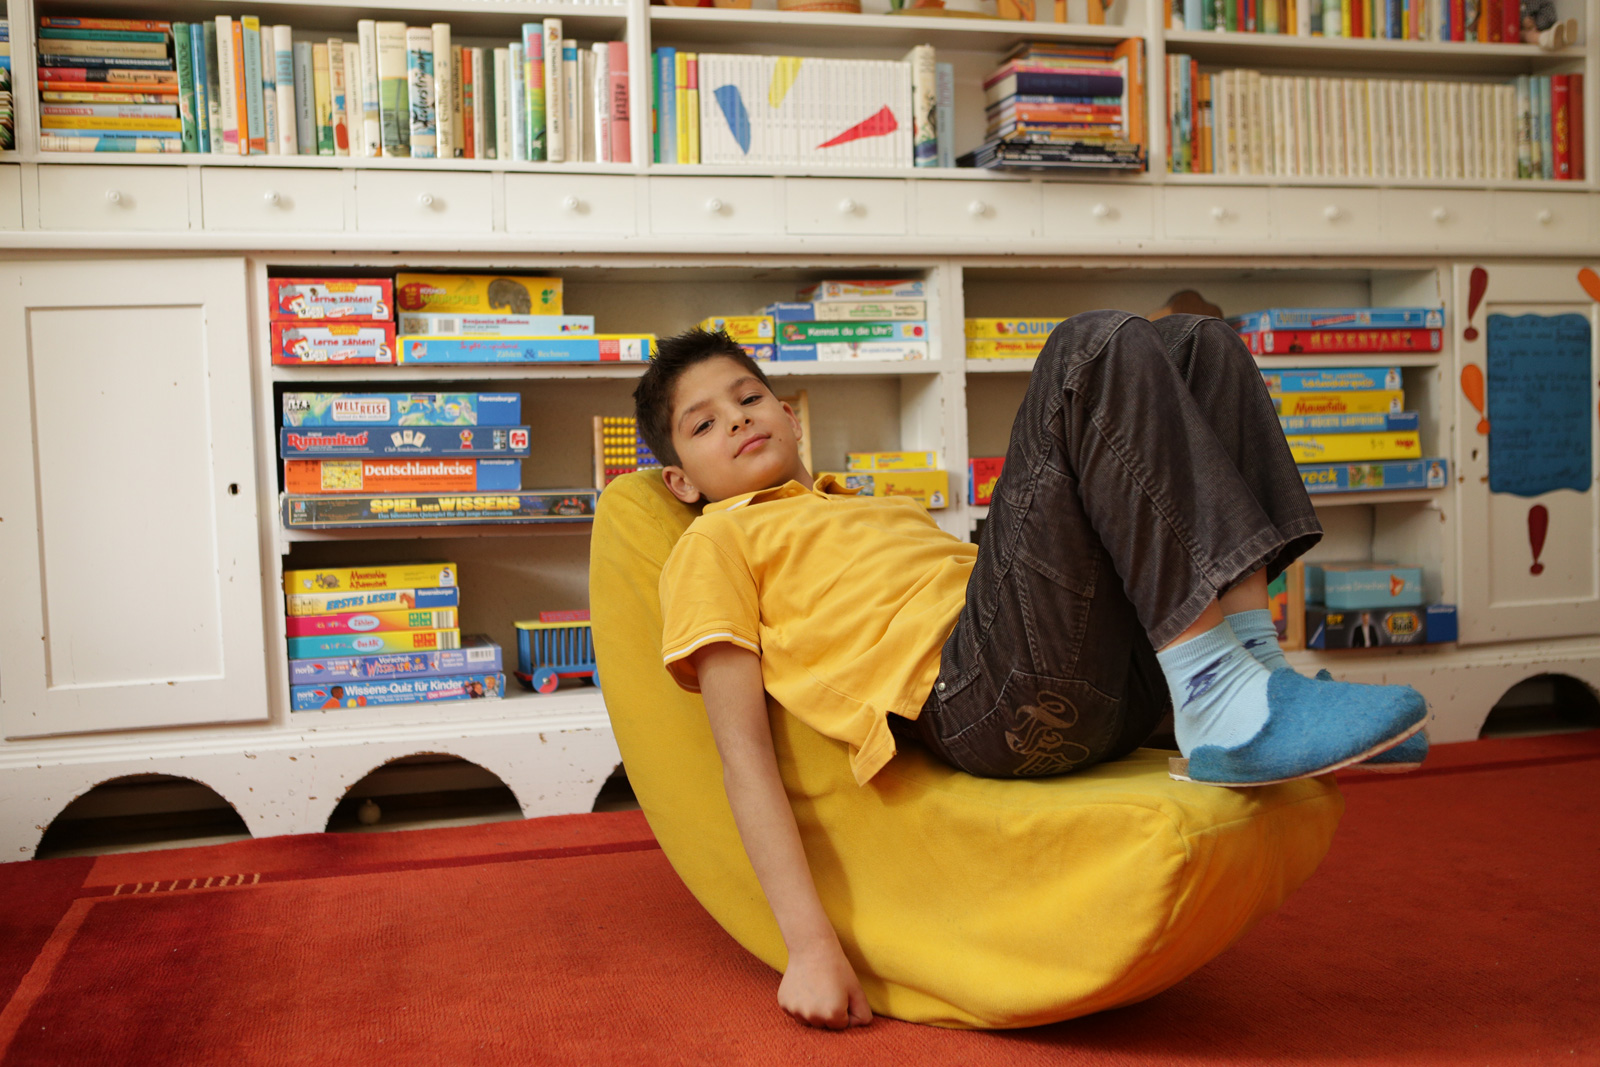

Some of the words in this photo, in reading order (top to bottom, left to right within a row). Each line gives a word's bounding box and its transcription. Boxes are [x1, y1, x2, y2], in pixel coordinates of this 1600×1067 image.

[808, 327, 839, 336] Kennst
[841, 327, 853, 336] du
[855, 327, 870, 336] die
[872, 326, 893, 335] Uhr?
[342, 338, 375, 346] zählen!
[497, 349, 522, 358] Zählen
[538, 350, 570, 358] Rechnen
[335, 402, 359, 412] WELT
[360, 405, 387, 414] REISE
[287, 433, 368, 451] Rummikub
[364, 461, 473, 476] Deutschlandreise
[1301, 467, 1338, 483] reck
[370, 498, 422, 513] SPIEL
[422, 504, 440, 512] DES
[438, 496, 521, 511] WISSENS
[326, 595, 364, 611] ERSTES
[366, 592, 397, 605] LESEN
[295, 665, 315, 675] noris
[344, 683, 412, 697] Wissens-Quiz
[414, 683, 429, 692] für
[430, 680, 463, 691] Kinder
